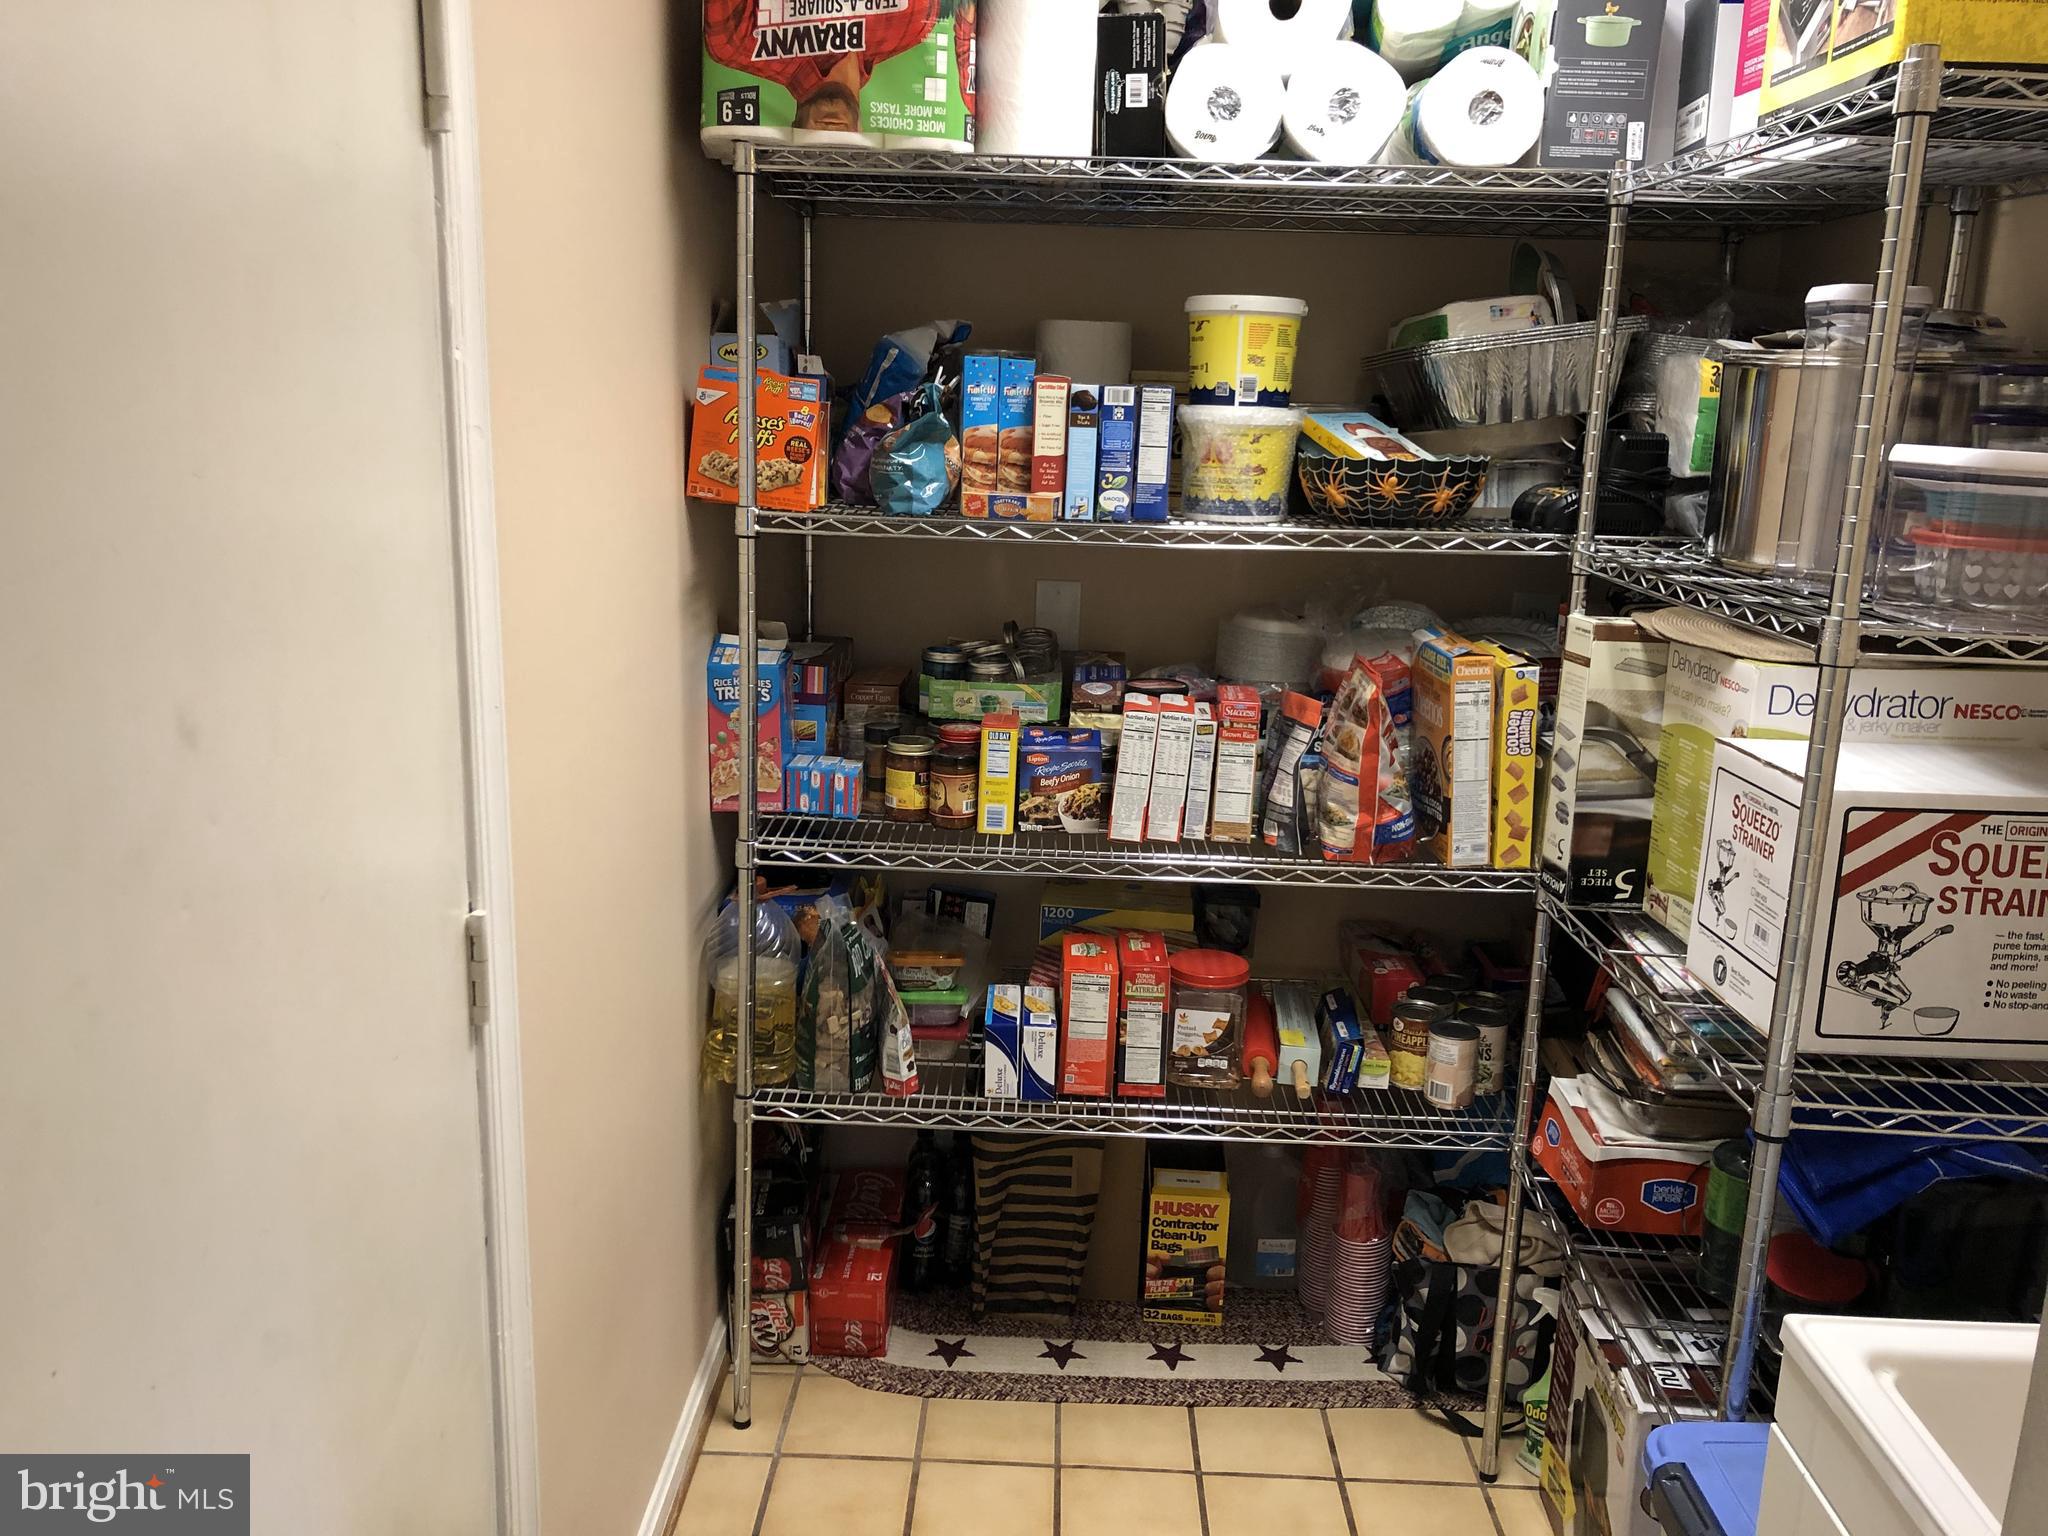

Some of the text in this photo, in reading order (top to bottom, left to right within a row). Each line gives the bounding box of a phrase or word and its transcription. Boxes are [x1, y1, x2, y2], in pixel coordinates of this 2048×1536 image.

[754, 20, 865, 59] BRAWNY
[870, 102, 946, 118] FOR MORE TASKS
[870, 116, 946, 133] MORE CHOICES
[724, 404, 786, 431] Rse's
[728, 428, 776, 449] Pffs
[1671, 649, 1741, 693] Dehydrator NESCO
[713, 678, 732, 688] RICE
[715, 687, 771, 702] TRETS
[1707, 699, 1731, 718] make?
[1767, 684, 1953, 720] Deydrator
[1953, 703, 2021, 721] NESCO
[1224, 706, 1256, 717] Success
[1858, 720, 1892, 735] jerky
[1896, 721, 1942, 733] maker
[989, 732, 1010, 740] OLD BAY
[1028, 755, 1049, 763] Lipton
[1040, 771, 1080, 787] Beefy Onion
[1732, 794, 1780, 842] SQUEEZO
[1981, 825, 2004, 835] THE
[2009, 825, 2048, 837] ORIGIN
[1732, 824, 1775, 863] STRAINER
[1928, 831, 2048, 884] SQUE
[1587, 868, 1608, 877] SET
[1541, 871, 1566, 895] ANOLON
[1580, 868, 1636, 900] 5 PIECE
[1936, 885, 2048, 918] STRAI
[1043, 908, 1075, 919] 1200
[2008, 930, 2023, 940] the
[1993, 942, 2048, 952] puree toma
[1991, 952, 2041, 962] pumpkins,
[1990, 962, 2038, 972] and more!
[1126, 985, 1165, 994] FLATBREAD
[1996, 980, 2047, 991] No peeling
[1994, 990, 2037, 999] No waste
[1993, 1000, 2007, 1009] No
[1176, 1030, 1203, 1038] Nuggets
[1393, 1030, 1428, 1047] INEAPPL
[1036, 1031, 1045, 1059] Deluxe
[995, 1067, 1004, 1095] Deluxe
[1154, 1200, 1220, 1219] HUSKY
[1152, 1216, 1219, 1231] Contractor
[1151, 1229, 1207, 1244] Clean-Up
[1151, 1240, 1183, 1254] Bags
[764, 1299, 788, 1334] diet
[1144, 1310, 1160, 1320] 32
[1160, 1312, 1184, 1321] BAGS
[790, 1345, 802, 1356] 12
[1525, 1403, 1548, 1421] Odo
